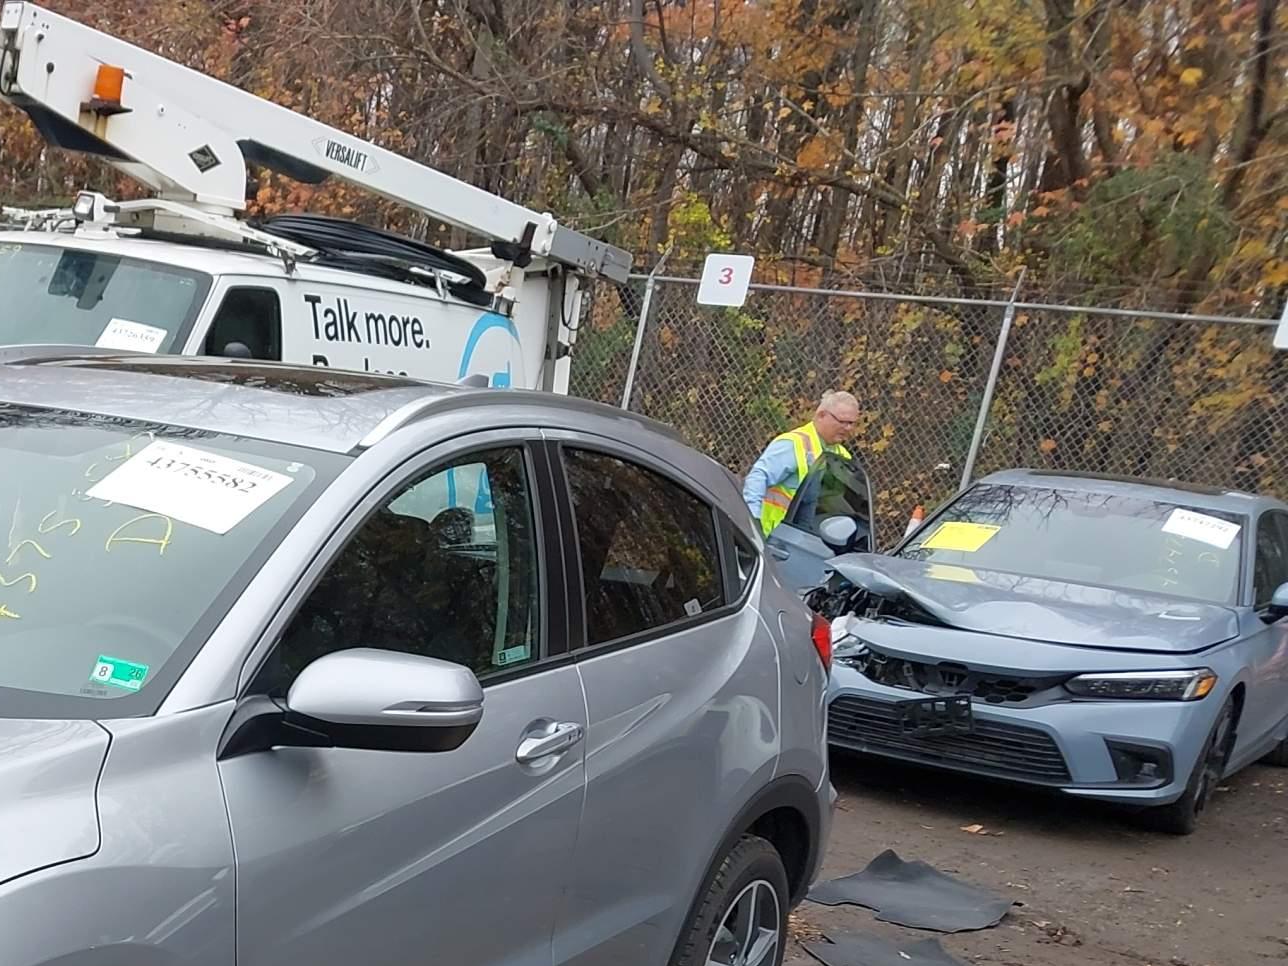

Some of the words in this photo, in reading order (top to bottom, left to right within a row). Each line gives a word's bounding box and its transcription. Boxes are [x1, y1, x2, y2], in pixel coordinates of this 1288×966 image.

[325, 140, 368, 172] VERSALIFT
[718, 267, 734, 285] 3
[304, 294, 362, 343] Talk
[364, 312, 431, 349] more.
[146, 456, 258, 494] 43755582
[105, 513, 172, 556] D
[98, 665, 109, 677] 8
[128, 667, 143, 681] 26
